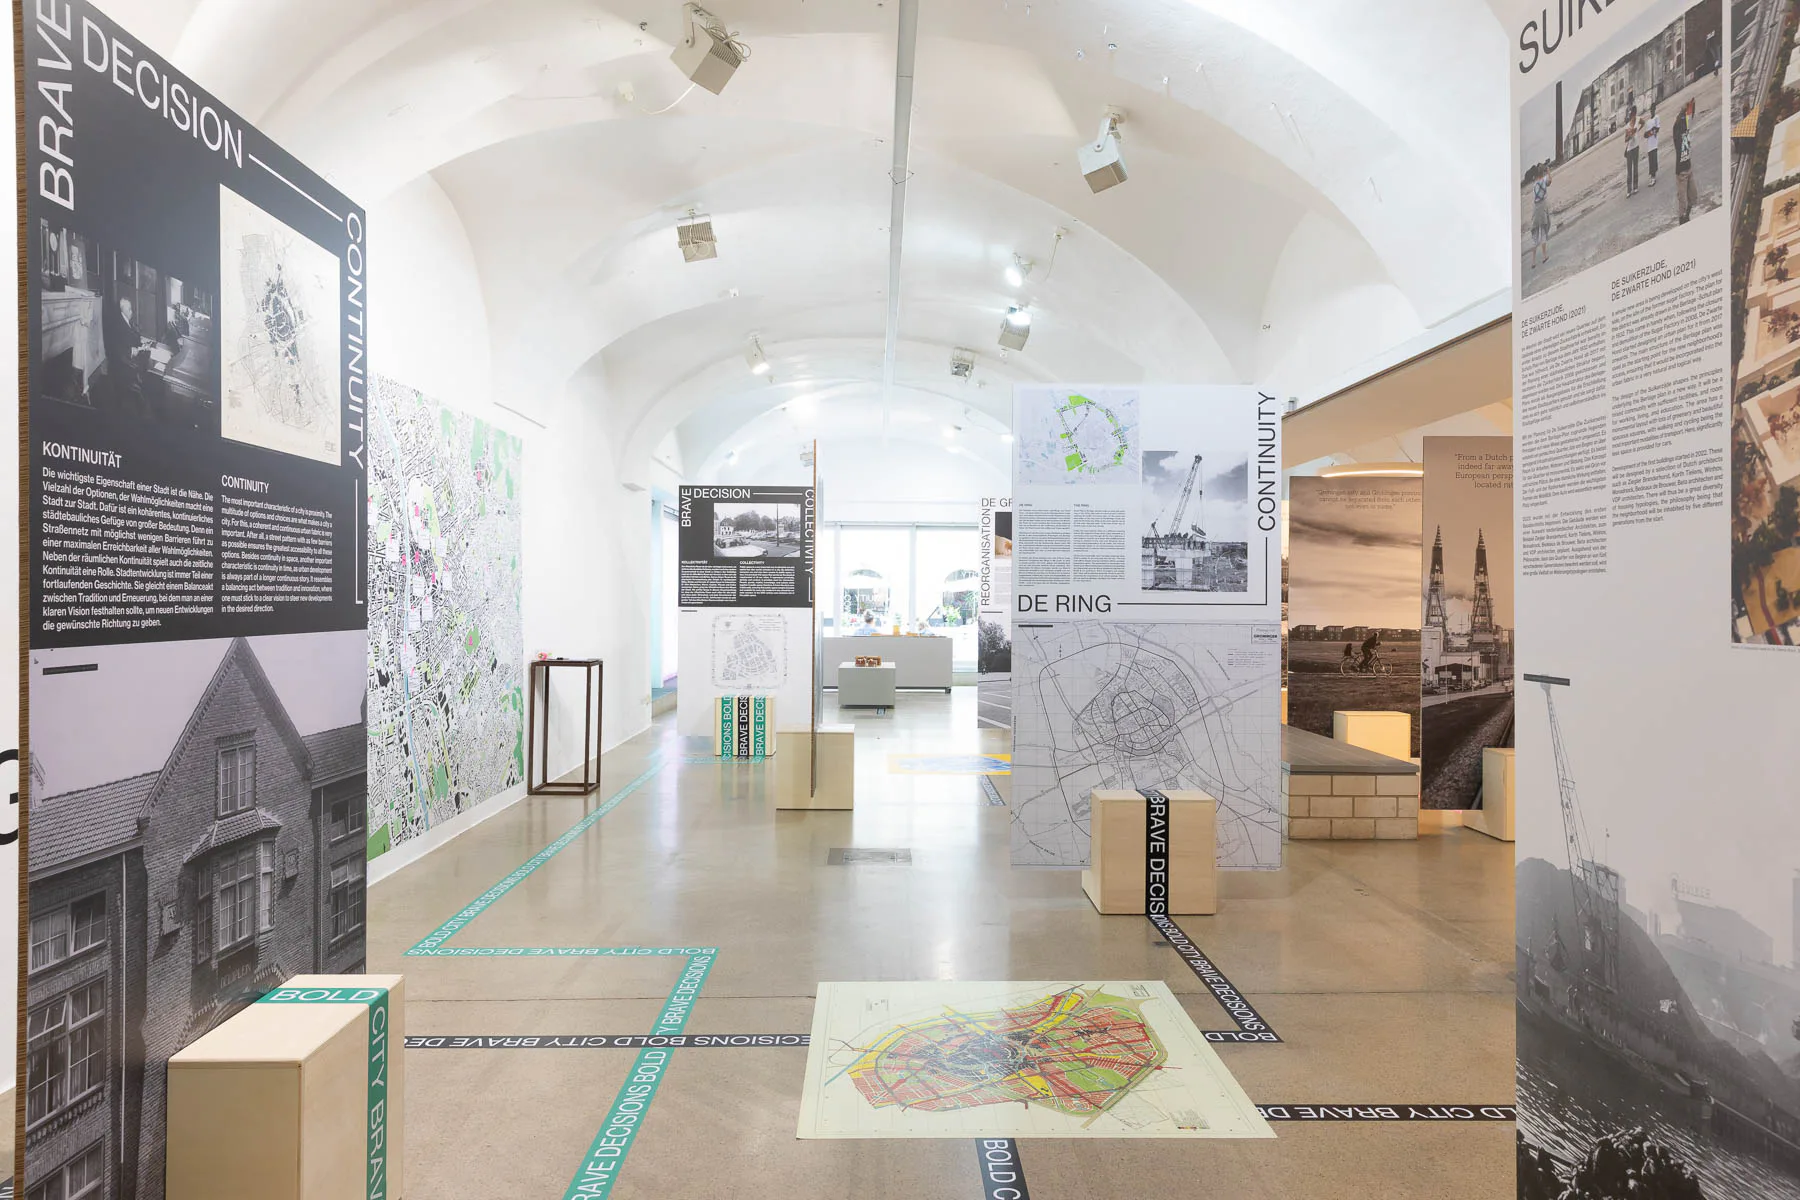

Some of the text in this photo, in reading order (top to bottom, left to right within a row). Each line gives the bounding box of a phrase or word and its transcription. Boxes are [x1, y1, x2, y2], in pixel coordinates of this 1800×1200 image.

[1519, 0, 1615, 73] SUIK
[36, 0, 242, 210] BRAVE DECISION
[1612, 259, 1696, 301] DE ZWARTE HOND (2021)
[1612, 281, 1620, 290] DE
[1522, 319, 1528, 328] DE
[1522, 330, 1528, 338] DE
[1529, 320, 1551, 336] ZWARTE
[1552, 312, 1568, 326] HOND
[346, 212, 364, 470] CONTINUITY
[42, 441, 122, 468] KONTINUITÄT
[1258, 392, 1276, 531] CONTINUITY
[42, 466, 55, 478] Die
[57, 469, 94, 487] wichtigste
[96, 475, 135, 493] Eigenschaft
[136, 481, 152, 492] einer
[221, 475, 269, 493] CONTINUITY
[1456, 472, 1490, 480] European
[42, 480, 71, 494] Vielzahl
[72, 485, 84, 496] der
[85, 486, 118, 503] Optionen,
[118, 491, 130, 502] der
[130, 493, 185, 511] Wahlmöglichkeiten
[42, 494, 63, 507] Stadt
[64, 499, 76, 508] zur
[99, 501, 117, 513] Dafür
[118, 504, 126, 514] ist
[127, 505, 137, 515] ein
[682, 488, 750, 527] BRAVE DECISION
[982, 498, 996, 507] DE
[42, 508, 100, 524] städtebauliches
[100, 514, 125, 529] Gefüge
[125, 519, 137, 528] von
[137, 518, 158, 532] großer
[805, 489, 814, 574] COLLECTIVITY
[42, 522, 89, 536] Straßennetz
[90, 527, 102, 537] mit
[103, 528, 136, 542] möglichst
[137, 531, 163, 545] wenigen
[981, 508, 990, 606] REORGANISATION
[42, 578, 93, 589] fortlaufenden
[94, 579, 133, 590] Geschichte.
[134, 580, 144, 590] Sie
[144, 581, 165, 593] gleicht
[1018, 594, 1111, 612] DE RING
[42, 620, 55, 630] die
[56, 619, 100, 633] gewünschte
[101, 618, 131, 631] Richtung
[140, 617, 161, 630] geben.
[740, 696, 748, 722] DECIS
[756, 696, 764, 755] BRAVE DECIS
[723, 722, 731, 758] CISIONS
[1150, 794, 1166, 853] BRAVE
[1163, 925, 1188, 945] BOLD
[1177, 943, 1201, 960] CITY
[1190, 959, 1218, 982] BRAVE
[1211, 982, 1266, 1030] DECISIONS
[418, 930, 451, 947] BOLD
[442, 918, 468, 930] CITY
[676, 956, 710, 995] DECISIONS
[662, 995, 693, 1025] BRAVE
[449, 1037, 537, 1048] BRAVE
[544, 1037, 608, 1047] CITY
[614, 1036, 686, 1046] BOLD
[694, 1035, 813, 1045] ECISIONS
[1205, 1032, 1278, 1042] BOLD
[269, 990, 385, 1200] BOLD CITY BRAV
[1294, 1107, 1399, 1118] BRAVE
[1408, 1107, 1474, 1118] CITY
[570, 1160, 616, 1200] RAVE
[594, 1084, 652, 1157] DECISIONS
[633, 1052, 667, 1084] BOLD
[984, 1140, 1016, 1183] BOLD
